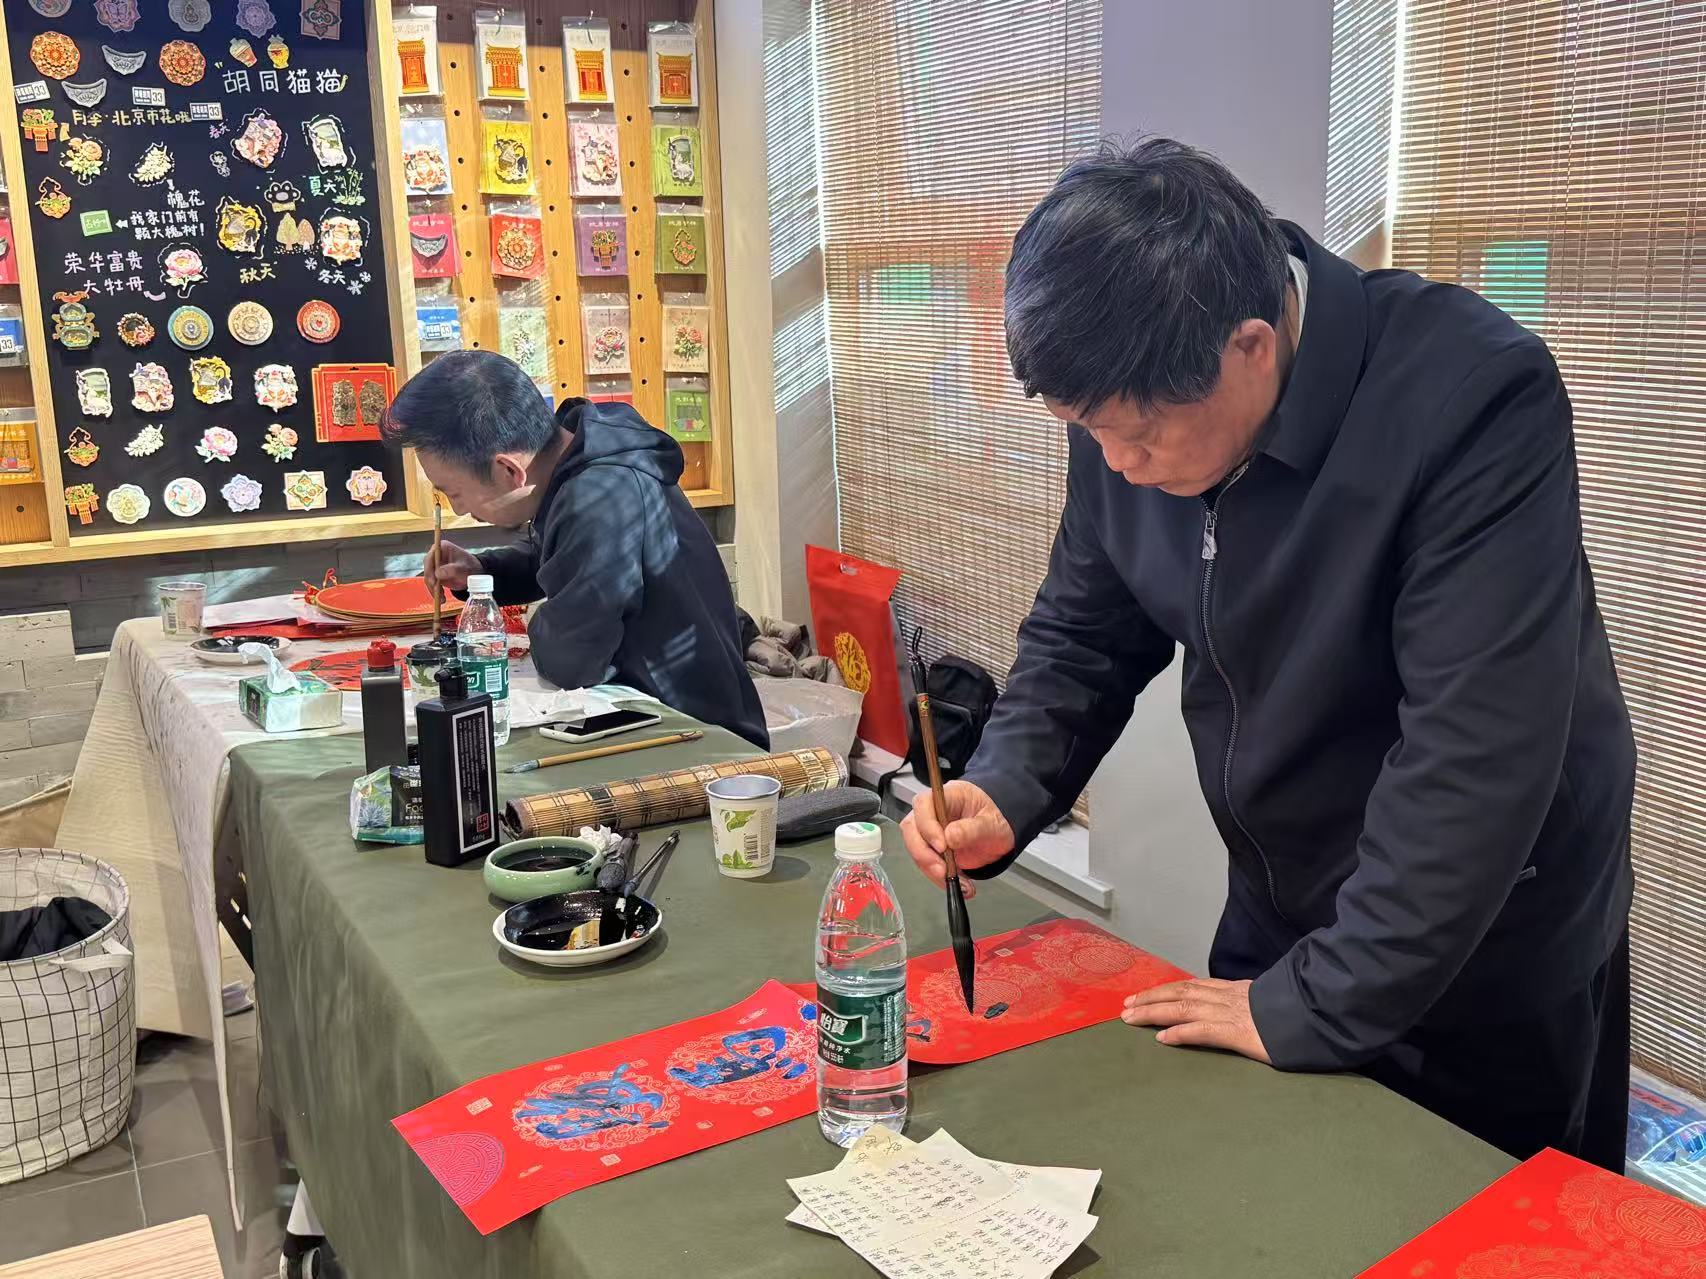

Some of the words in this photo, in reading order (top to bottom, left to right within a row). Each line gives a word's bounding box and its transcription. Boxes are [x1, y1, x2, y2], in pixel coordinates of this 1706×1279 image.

[309, 175, 337, 197] 夏天
[130, 209, 199, 226] 我家门前有
[64, 249, 144, 274] 荣华富贵
[239, 262, 276, 284] 秋天
[317, 268, 346, 285] 冬天
